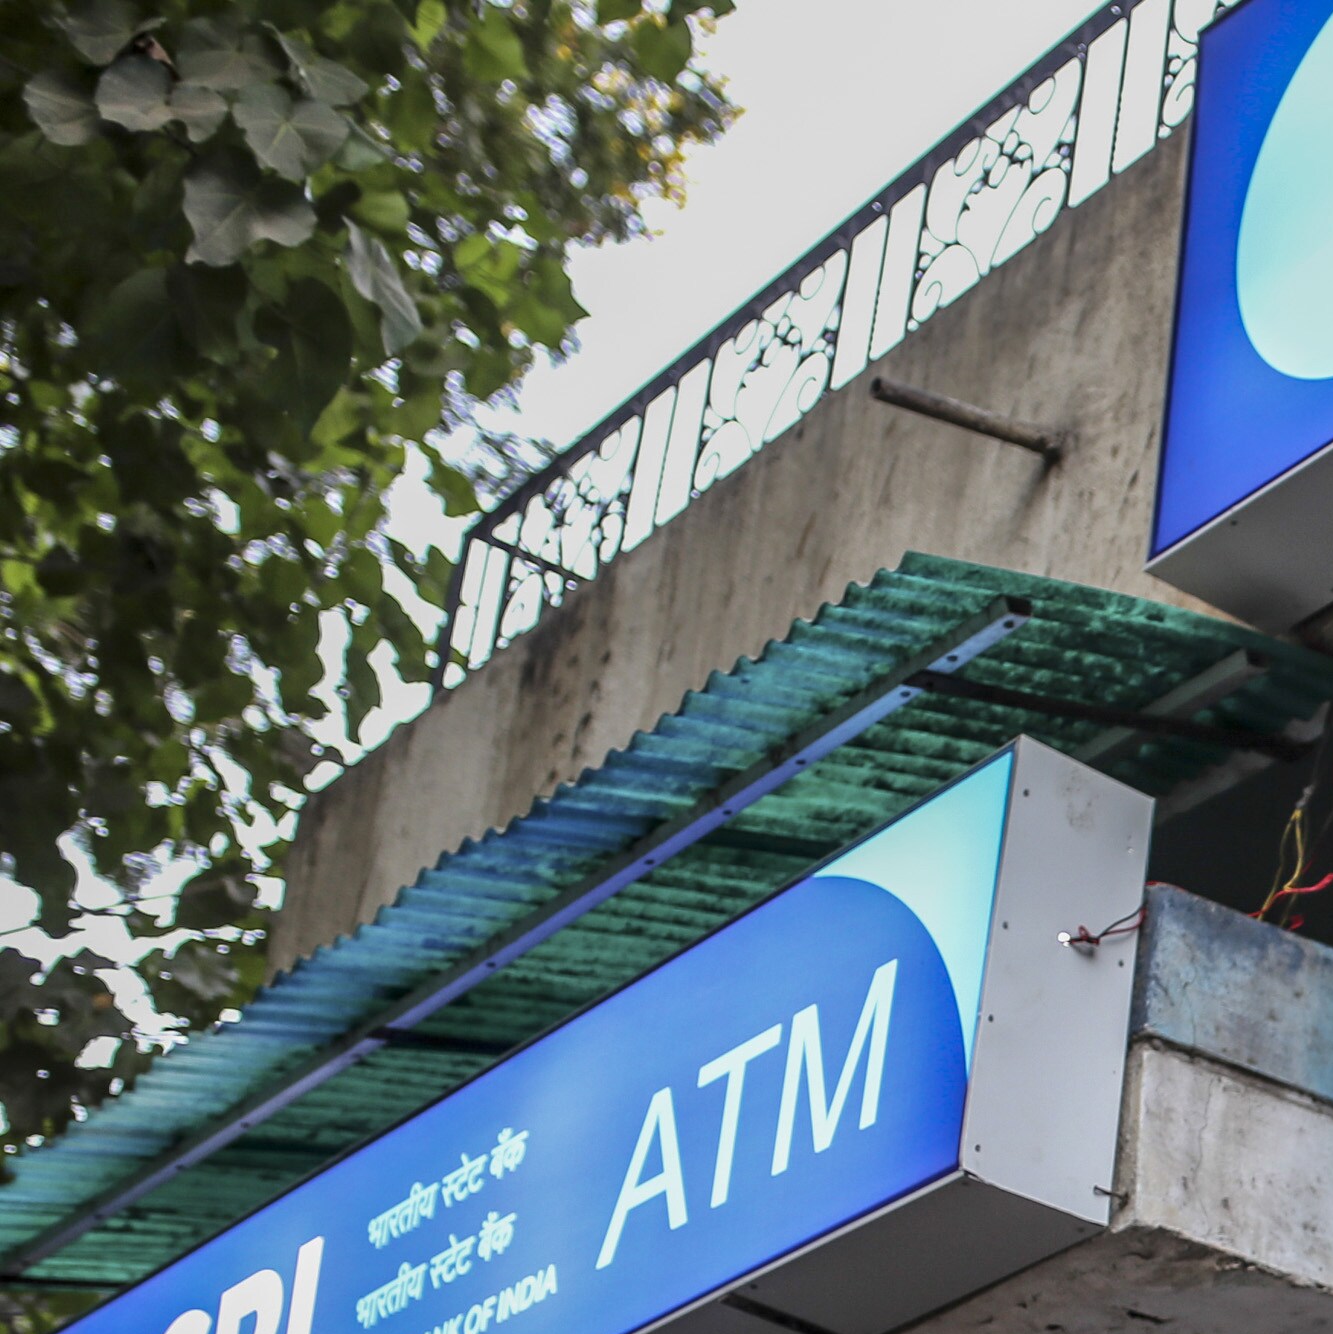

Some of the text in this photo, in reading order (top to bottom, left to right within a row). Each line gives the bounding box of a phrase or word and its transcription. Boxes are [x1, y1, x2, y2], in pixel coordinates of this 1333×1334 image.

[597, 959, 897, 1270] ATM
[368, 1182, 440, 1249] भारतीय
[441, 1152, 488, 1207] स्टेट
[356, 1261, 428, 1329] भारतीय
[430, 1234, 477, 1289] स्टेट
[496, 1264, 557, 1323] INDIA
